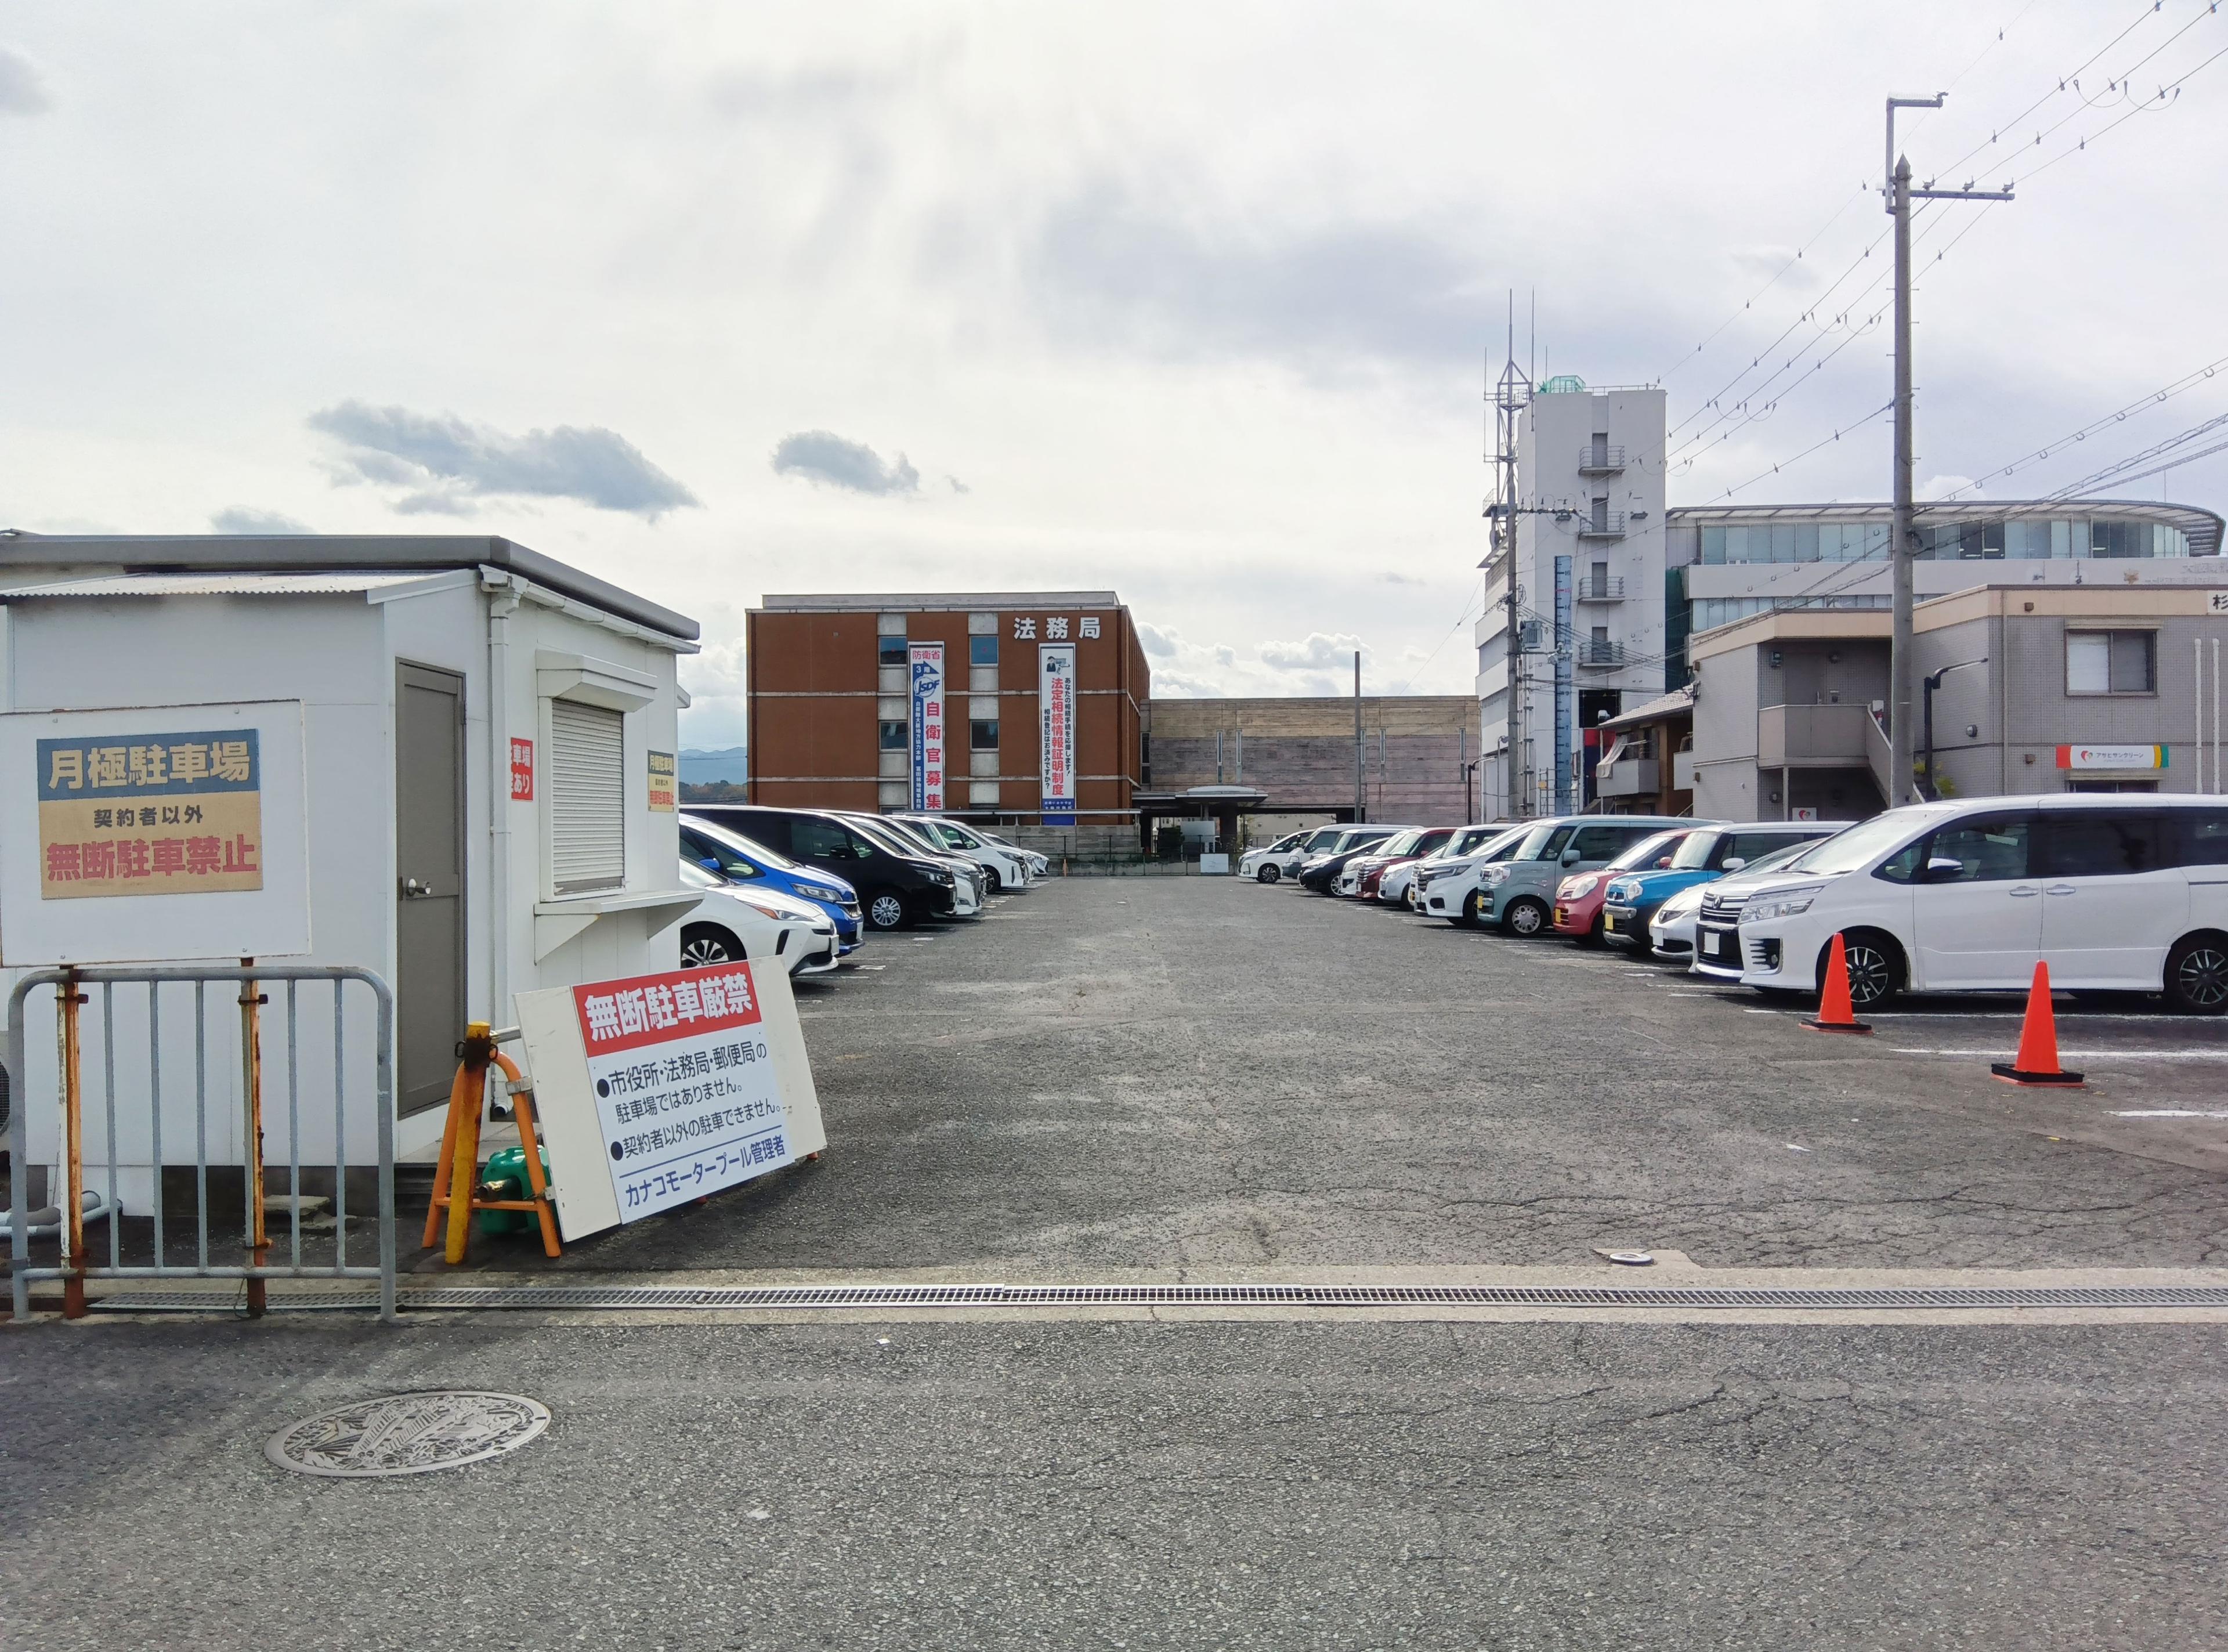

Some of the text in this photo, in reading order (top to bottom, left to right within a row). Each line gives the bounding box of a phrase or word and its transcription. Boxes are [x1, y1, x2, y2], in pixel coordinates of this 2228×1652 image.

[1014, 617, 1101, 640] 法務局
[913, 650, 941, 660] 防衛省
[916, 679, 940, 695] JSDF
[511, 744, 531, 768] 車場
[925, 701, 942, 809] 自衛官募集
[1051, 677, 1064, 796] 法定相続情報証明制度
[49, 740, 250, 790] 月極駐車場
[511, 772, 530, 794] あり
[93, 805, 204, 828] 契約者以外
[47, 834, 257, 881] 無断駐車禁止
[584, 972, 753, 1042] 無断駐車厳禁
[616, 1078, 743, 1125] 駐車場ではありません。
[623, 1098, 781, 1159] 契約者以外の駐車できません。
[625, 1134, 786, 1208] カナコモータープール管理者
